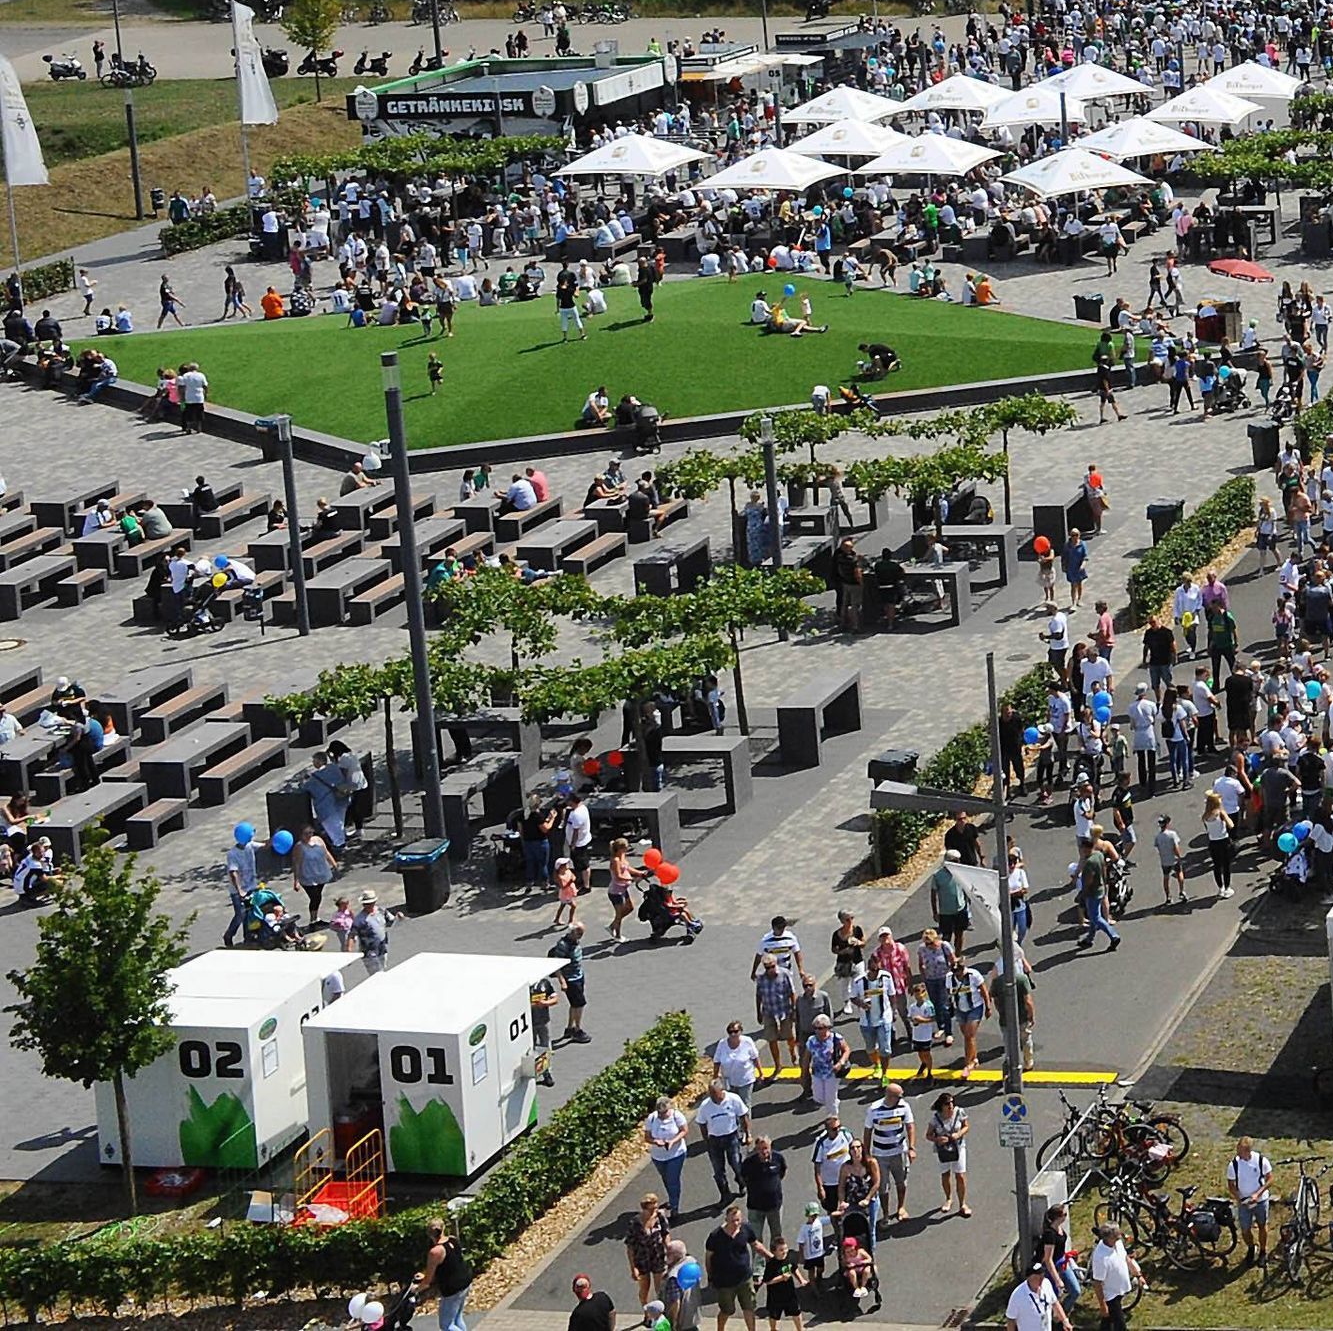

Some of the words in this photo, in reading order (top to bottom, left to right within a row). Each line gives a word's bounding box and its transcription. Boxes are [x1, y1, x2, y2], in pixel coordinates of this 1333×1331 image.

[509, 1012, 530, 1042] 01
[178, 1040, 245, 1079] 02
[390, 1045, 454, 1085] 01
